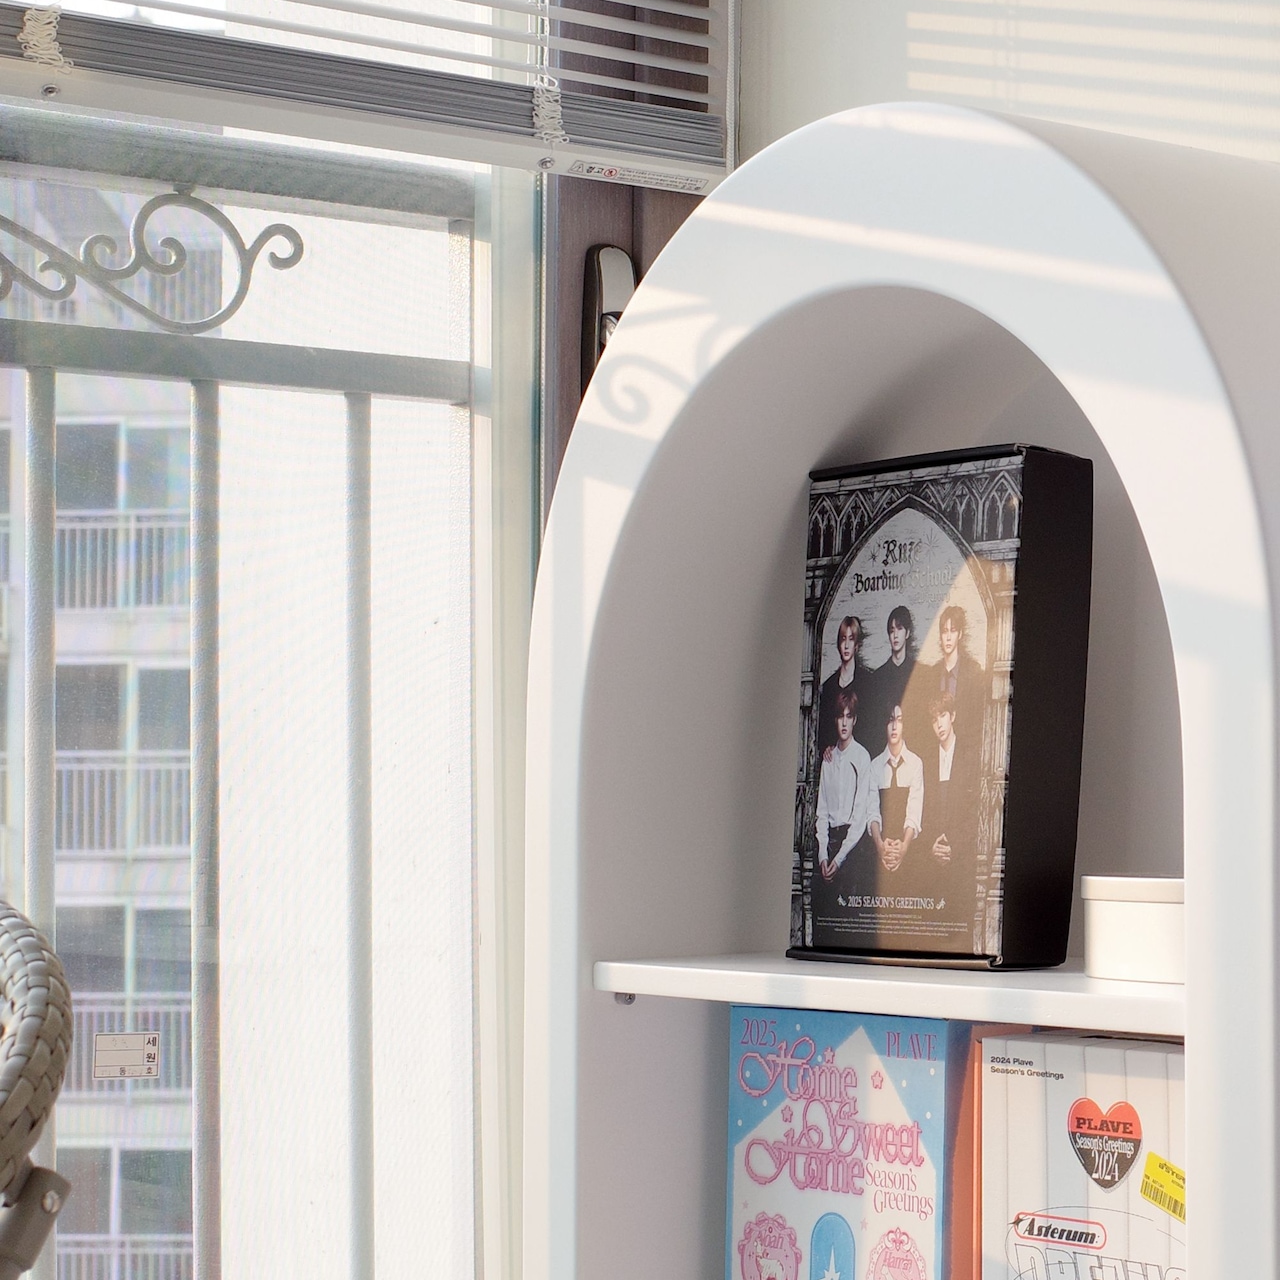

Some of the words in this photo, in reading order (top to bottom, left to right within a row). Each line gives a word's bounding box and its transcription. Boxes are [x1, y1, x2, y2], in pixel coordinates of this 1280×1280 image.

[853, 570, 906, 594] Boarding
[848, 895, 862, 908] 2025
[863, 896, 895, 909] SEASON'S
[895, 897, 935, 910] GREETINGS
[740, 1019, 777, 1047] 2025
[886, 1031, 938, 1061] PLAVE
[738, 1036, 858, 1103] Home
[990, 1056, 1011, 1065] 2024
[1013, 1058, 1034, 1067] Plave
[990, 1066, 1025, 1076] Season's
[1027, 1069, 1065, 1081] Greetings
[1075, 1117, 1134, 1135] PLAVE
[1075, 1133, 1103, 1151] Season's
[1103, 1136, 1135, 1158] Greetings
[745, 1125, 865, 1195] Home
[1091, 1149, 1120, 1182] 2024
[865, 1162, 917, 1192] Season's
[873, 1190, 934, 1221] Greetings
